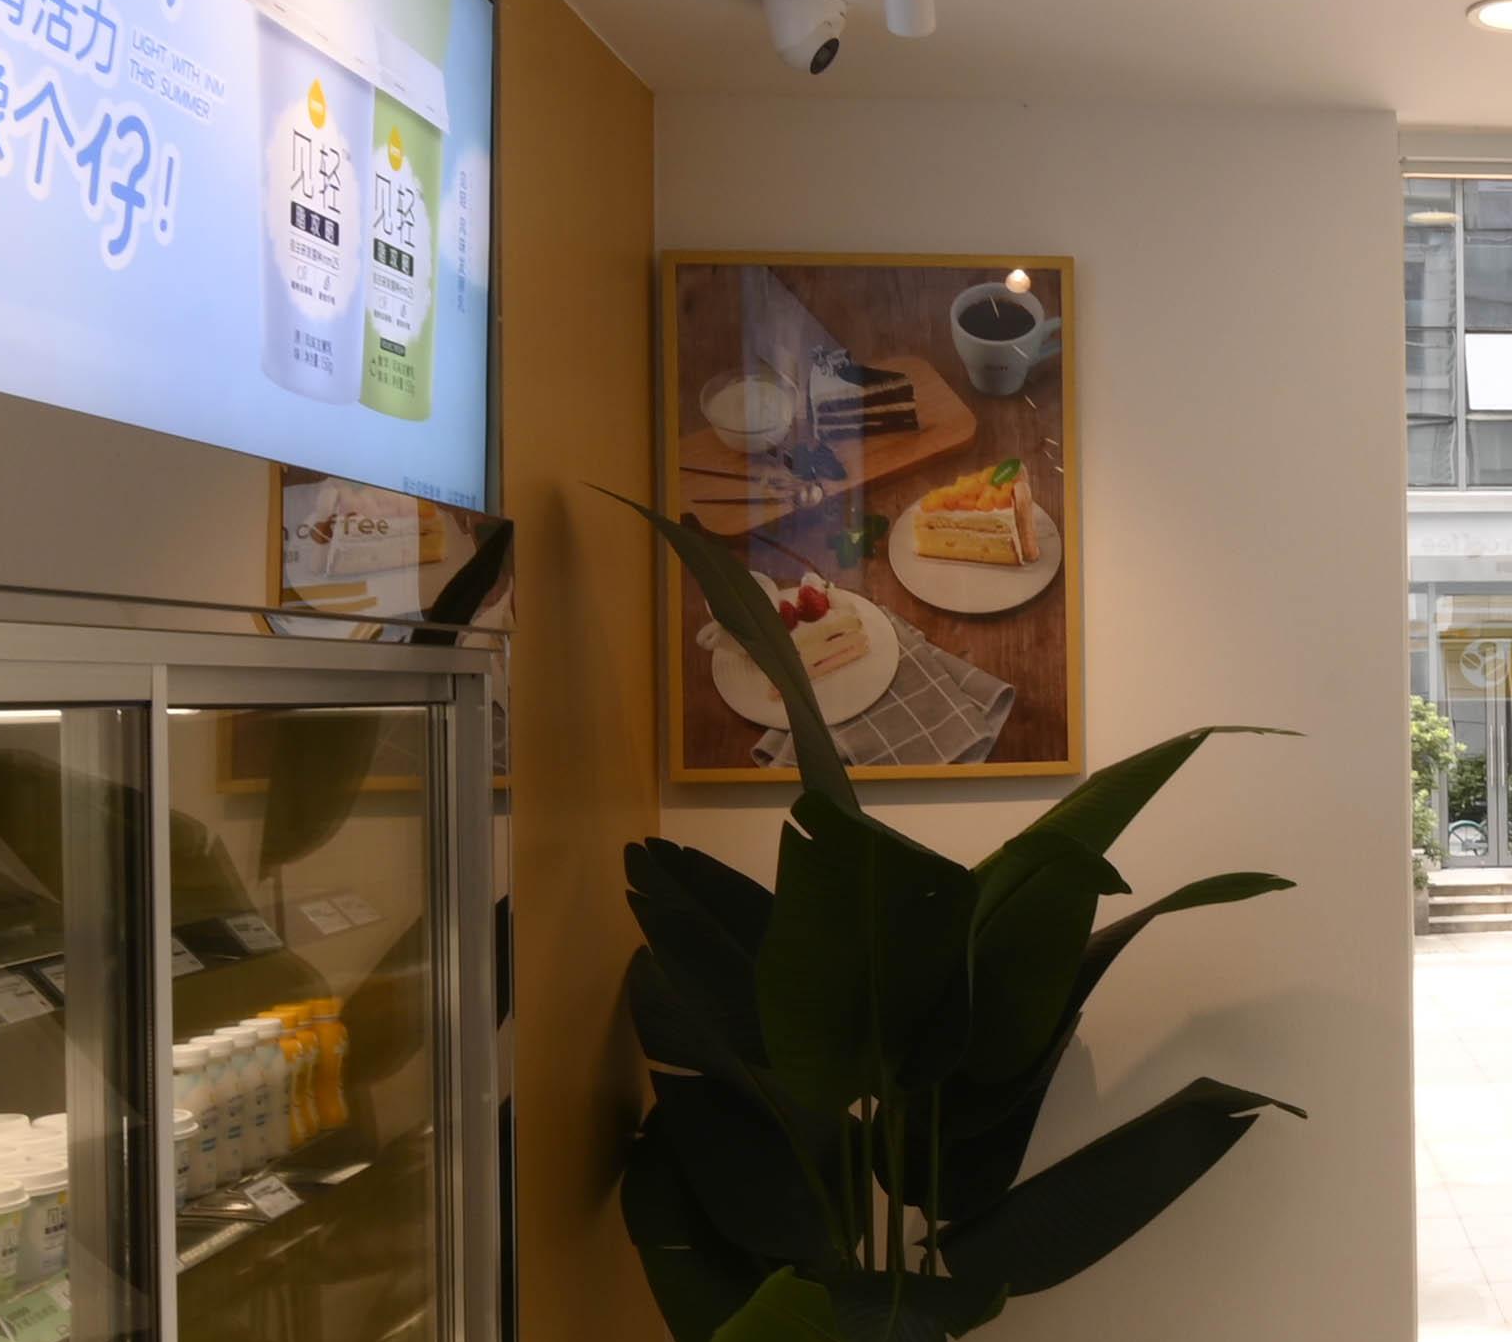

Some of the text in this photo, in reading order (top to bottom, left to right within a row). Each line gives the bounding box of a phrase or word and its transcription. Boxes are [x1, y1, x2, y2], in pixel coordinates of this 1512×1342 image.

[129, 58, 211, 120] THIS SUMMER
[171, 52, 201, 83] WITH
